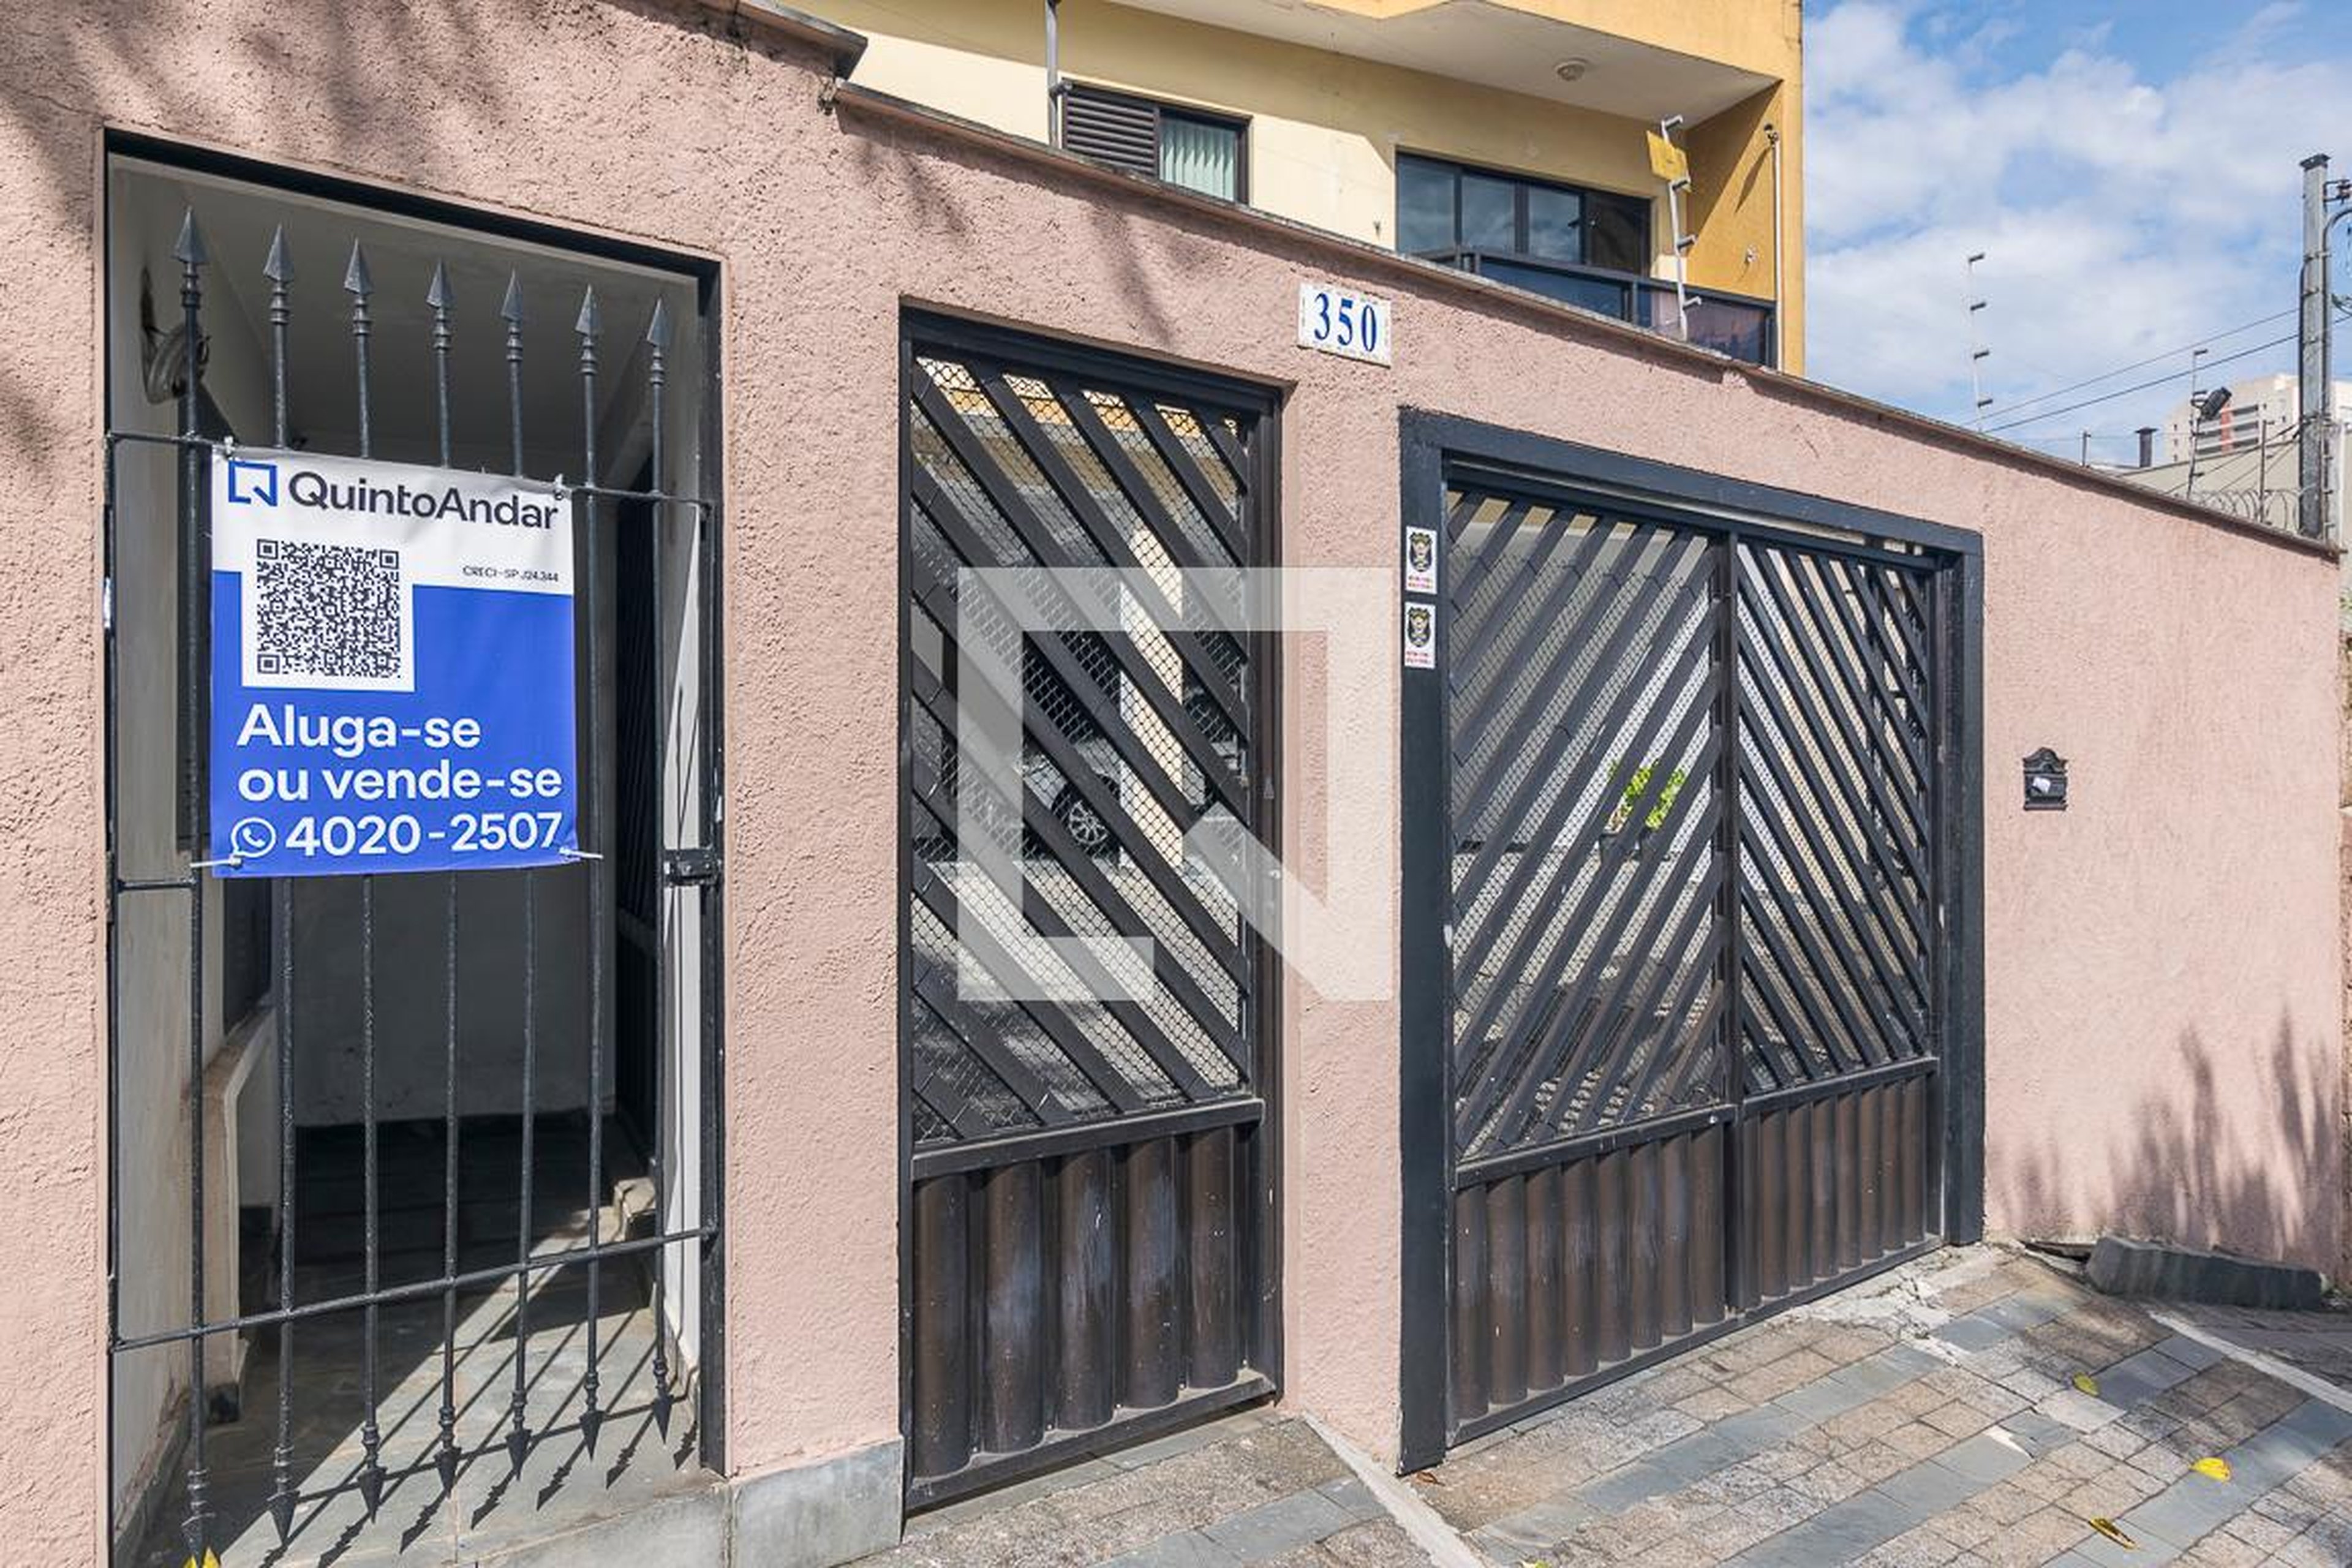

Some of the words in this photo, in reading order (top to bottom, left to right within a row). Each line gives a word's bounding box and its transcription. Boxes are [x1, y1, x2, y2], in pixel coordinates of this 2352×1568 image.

[1314, 293, 1376, 352] 350
[288, 472, 558, 529] QuintoAndar
[236, 704, 481, 757] Aluga-se
[238, 768, 307, 801] ou
[322, 759, 563, 799] vende-se
[285, 812, 563, 856] 4020-2507
